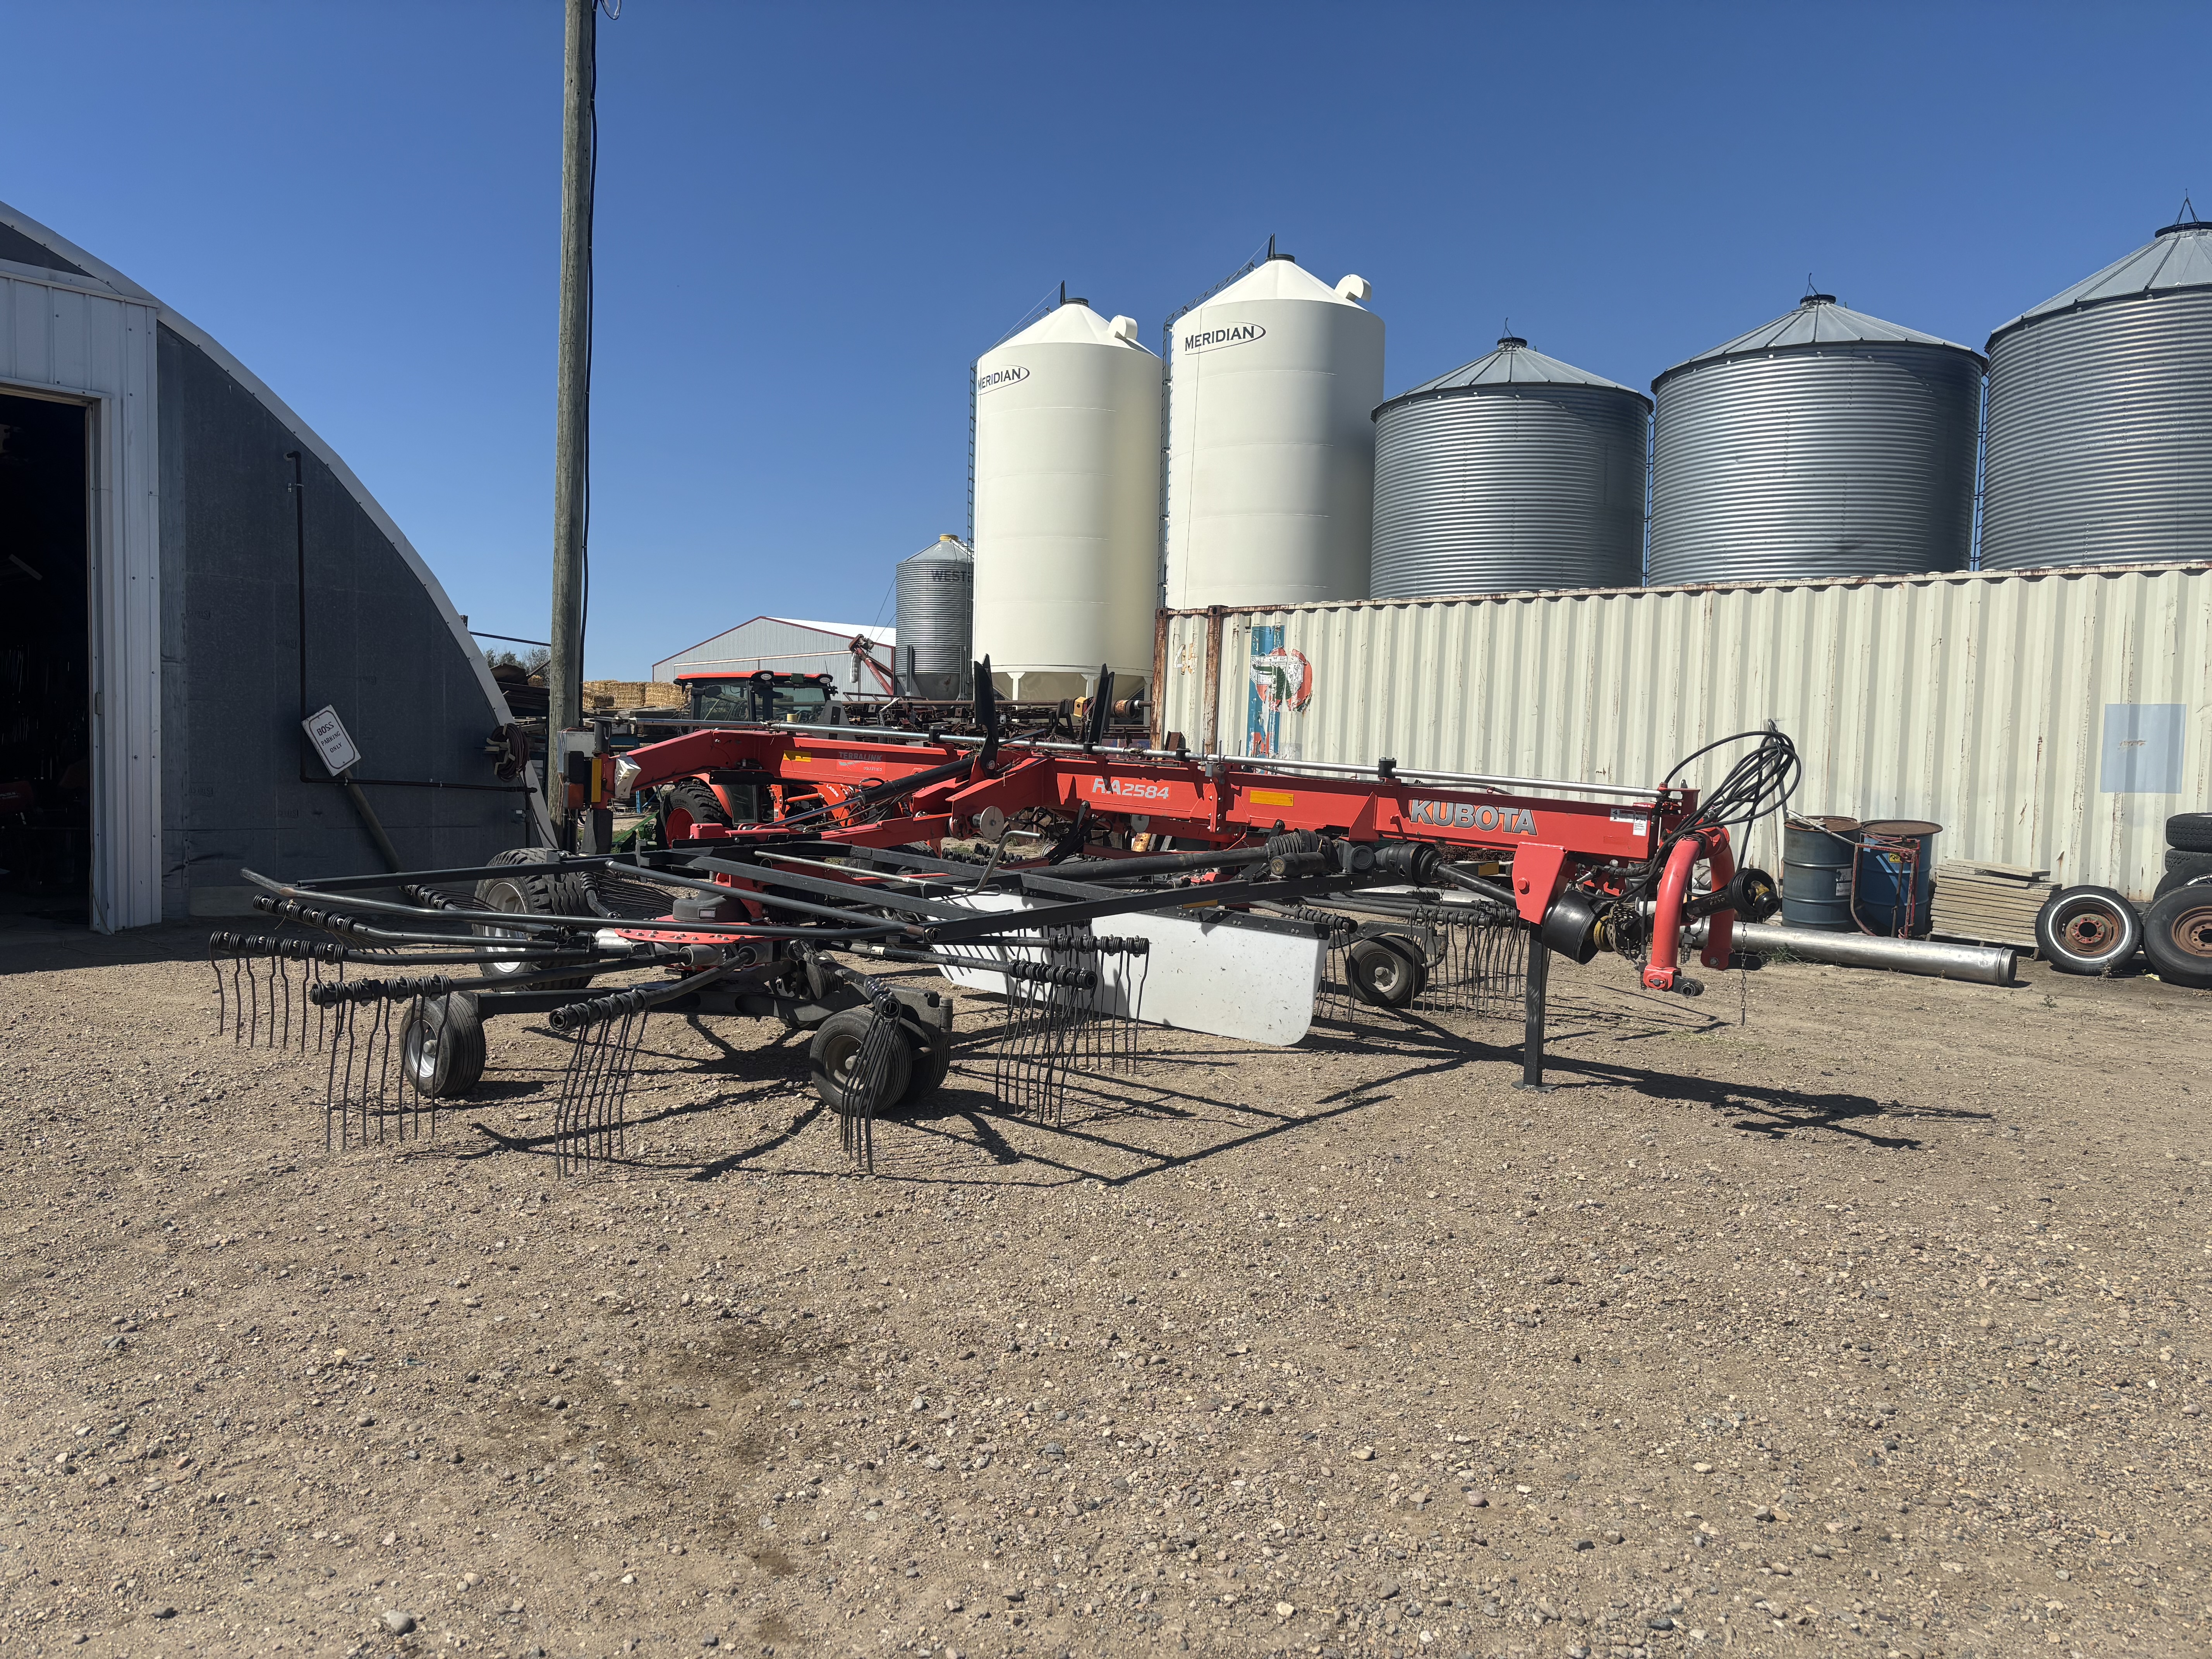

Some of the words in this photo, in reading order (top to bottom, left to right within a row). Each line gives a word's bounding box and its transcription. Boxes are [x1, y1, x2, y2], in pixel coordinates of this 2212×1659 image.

[1185, 326, 1254, 351] MERIDIAN
[978, 368, 1020, 392] MERIDIAN
[316, 721, 334, 736] BOSS
[321, 731, 341, 746] PARKING
[330, 742, 342, 753] ONLY
[839, 752, 882, 762] TERRALINK
[1092, 778, 1169, 799] RA2584
[1410, 798, 1538, 836] KUBOTA
